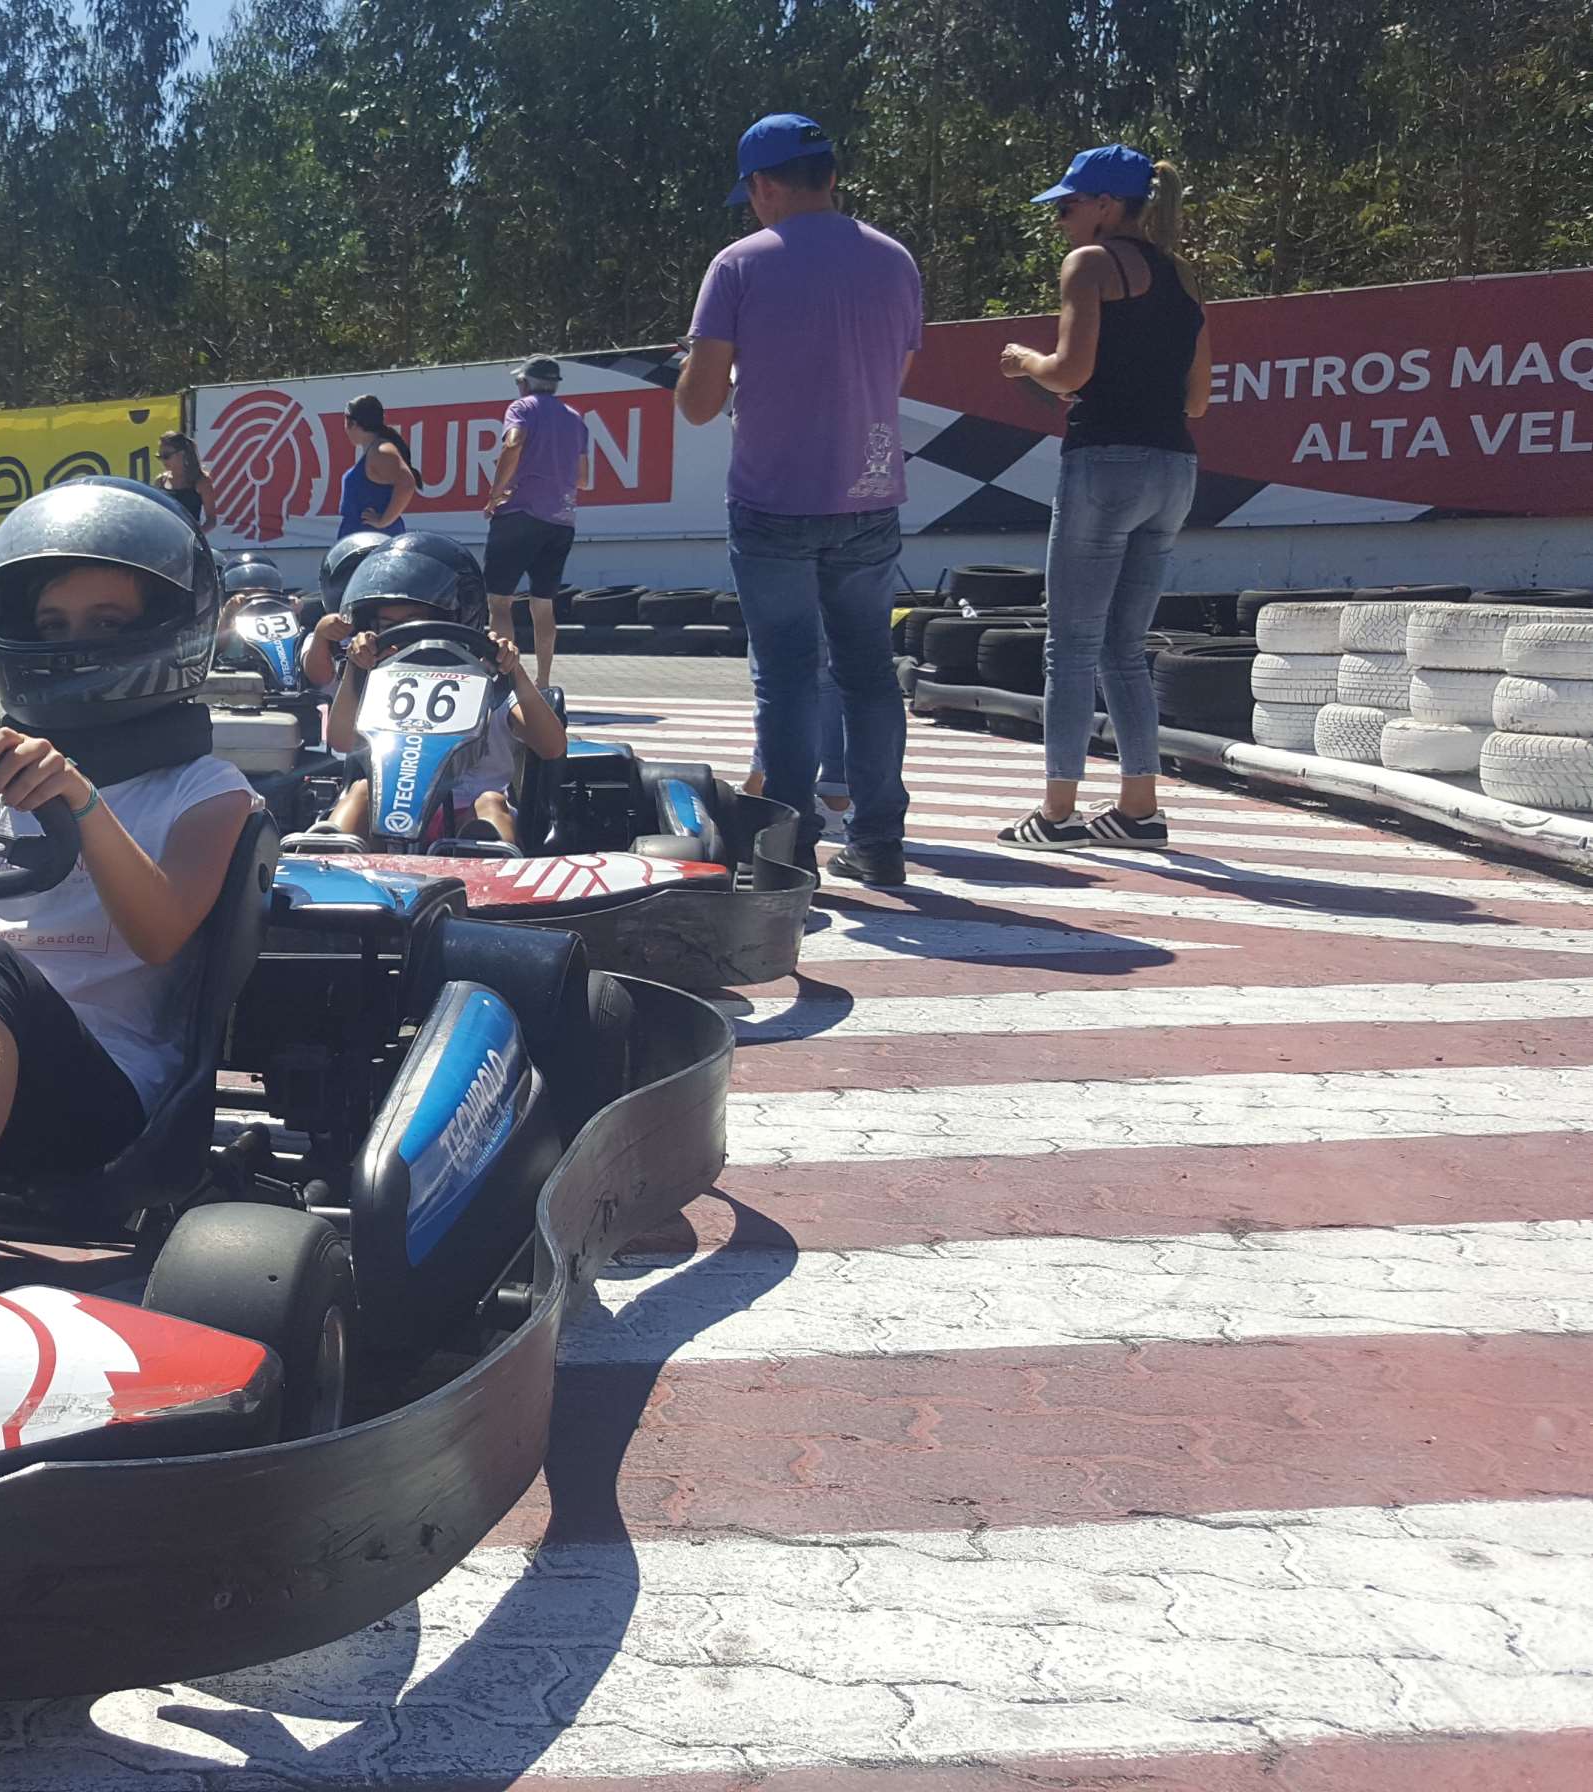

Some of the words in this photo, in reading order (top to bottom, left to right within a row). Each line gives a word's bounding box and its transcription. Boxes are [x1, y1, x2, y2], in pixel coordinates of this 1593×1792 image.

[1292, 415, 1450, 464] ALTA
[1469, 410, 1593, 457] VEL
[255, 615, 291, 636] 63
[389, 671, 471, 682] UROINDY
[388, 677, 460, 724] 66
[392, 734, 423, 811] TECNIROLO
[37, 933, 95, 945] garden
[438, 1049, 507, 1171] TECNIROLO
